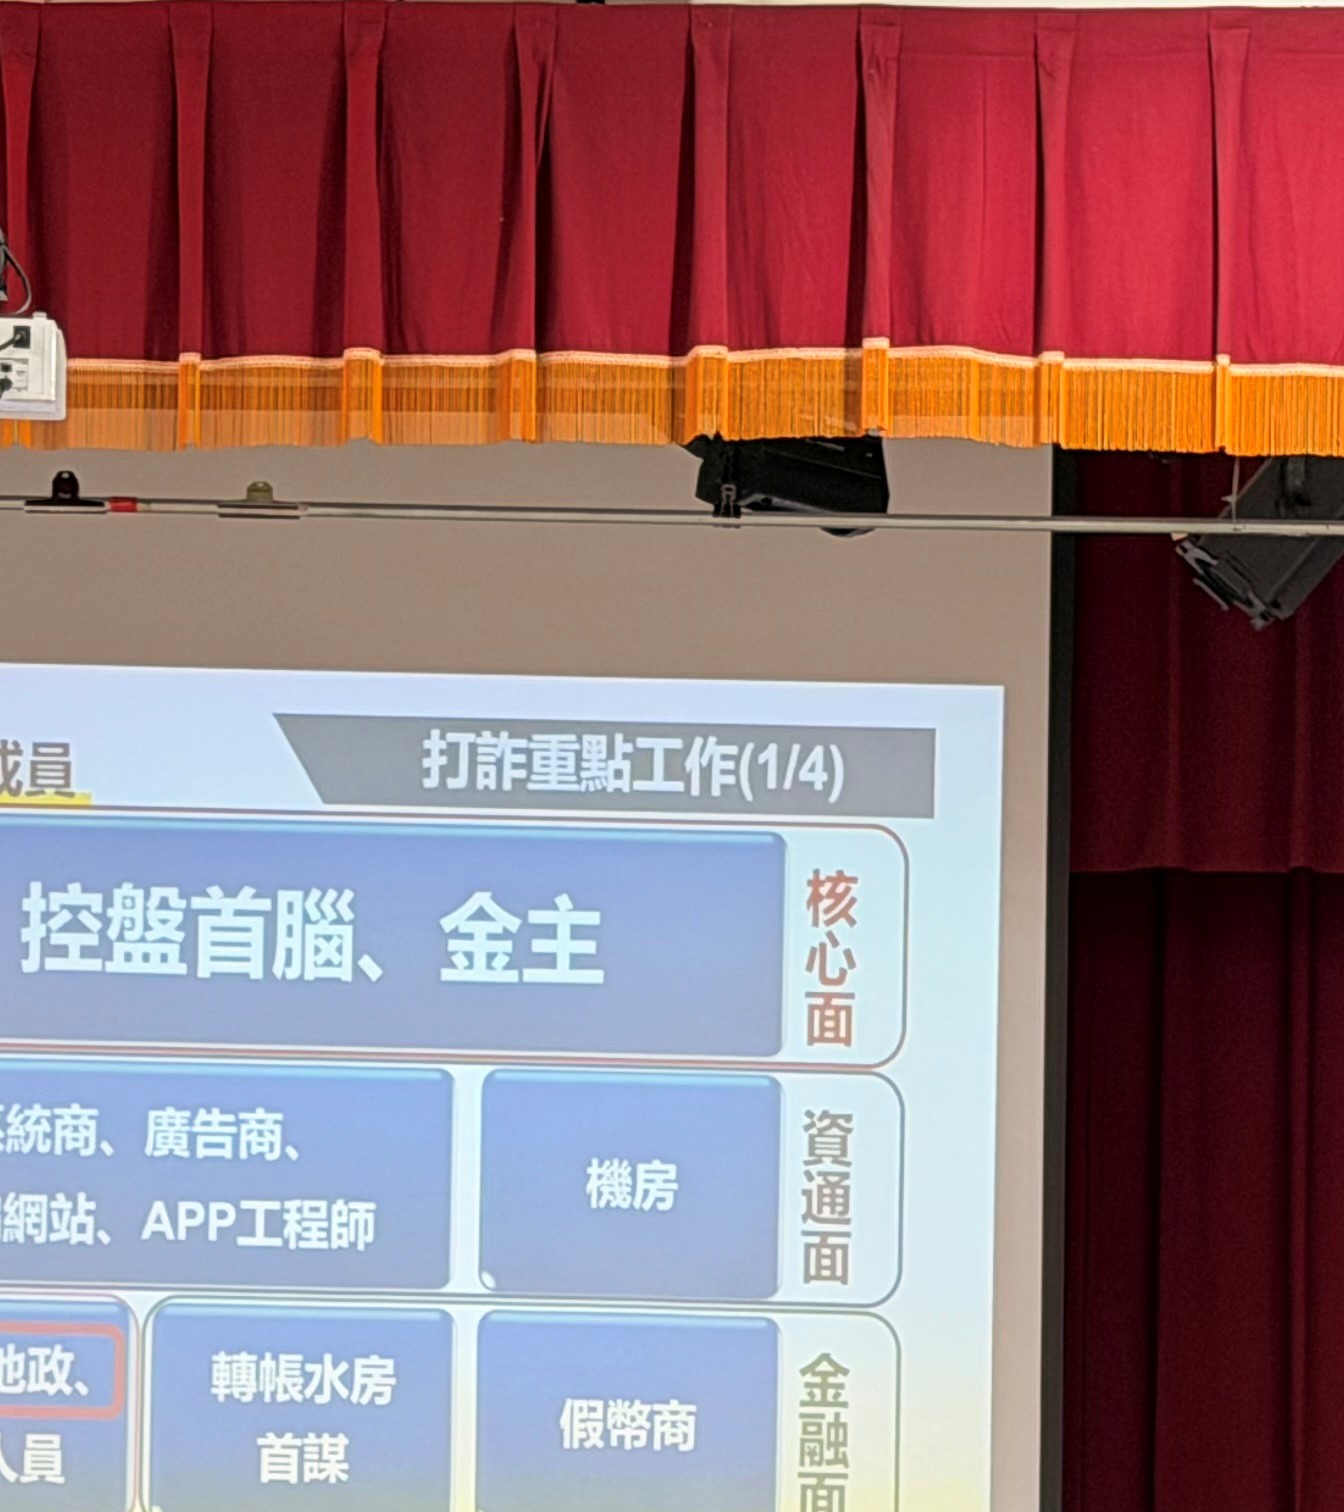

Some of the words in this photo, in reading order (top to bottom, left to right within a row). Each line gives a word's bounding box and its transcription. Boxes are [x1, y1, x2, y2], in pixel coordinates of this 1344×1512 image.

[806, 869, 859, 1047] 核心面
[586, 1158, 679, 1211] 機房
[801, 1109, 853, 1286] 資通面
[210, 1352, 397, 1406] 轉帳水房
[559, 1398, 697, 1453] 假幣商
[257, 1433, 350, 1485] 首謀
